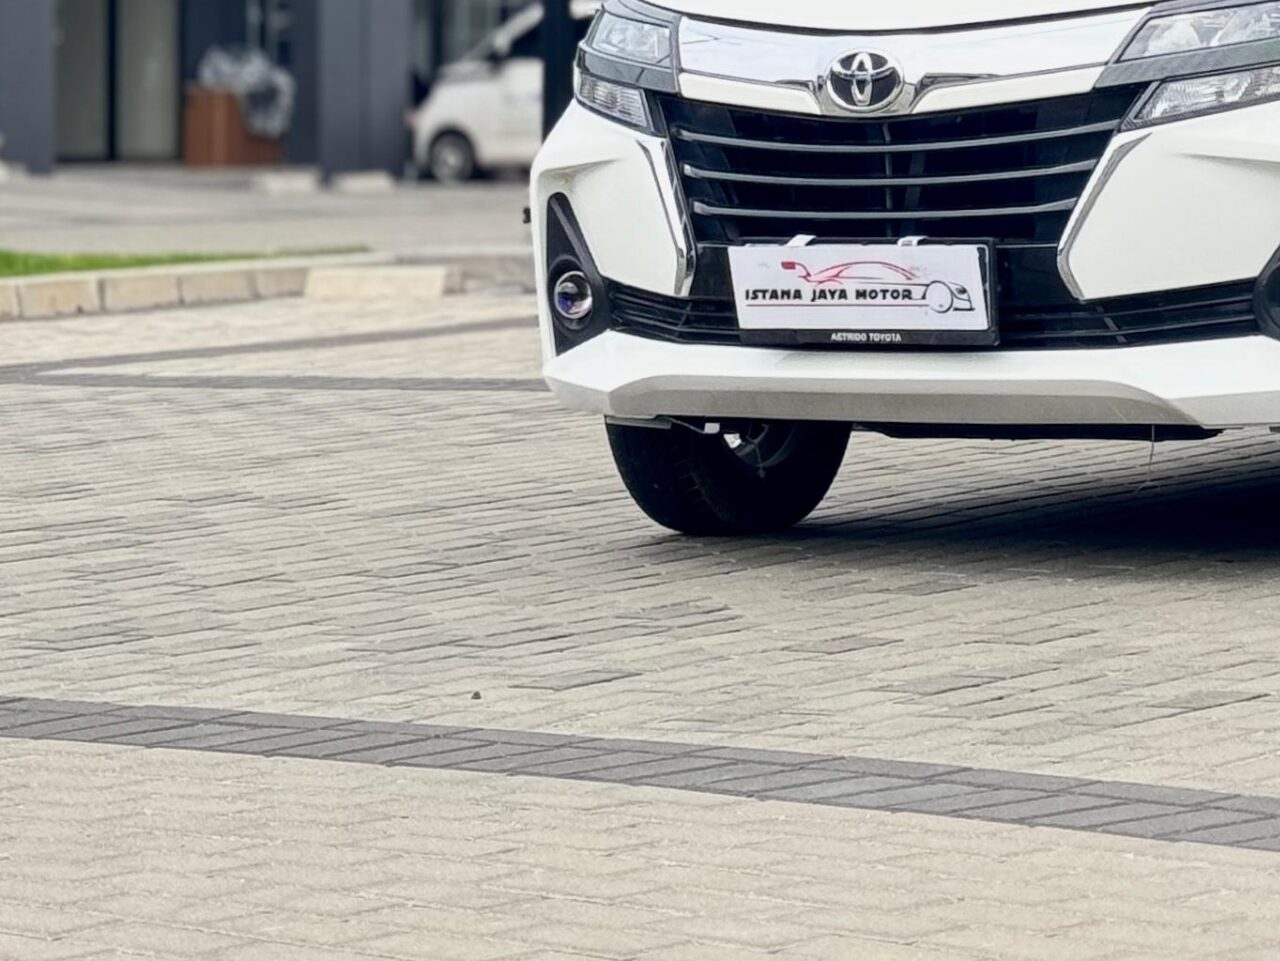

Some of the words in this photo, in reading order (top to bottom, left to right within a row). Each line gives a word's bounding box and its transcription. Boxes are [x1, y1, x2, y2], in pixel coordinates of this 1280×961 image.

[745, 288, 803, 301] ISTANA
[810, 288, 848, 303] JAYA
[855, 288, 913, 301] MOTOR
[868, 331, 902, 343] TOYOTA
